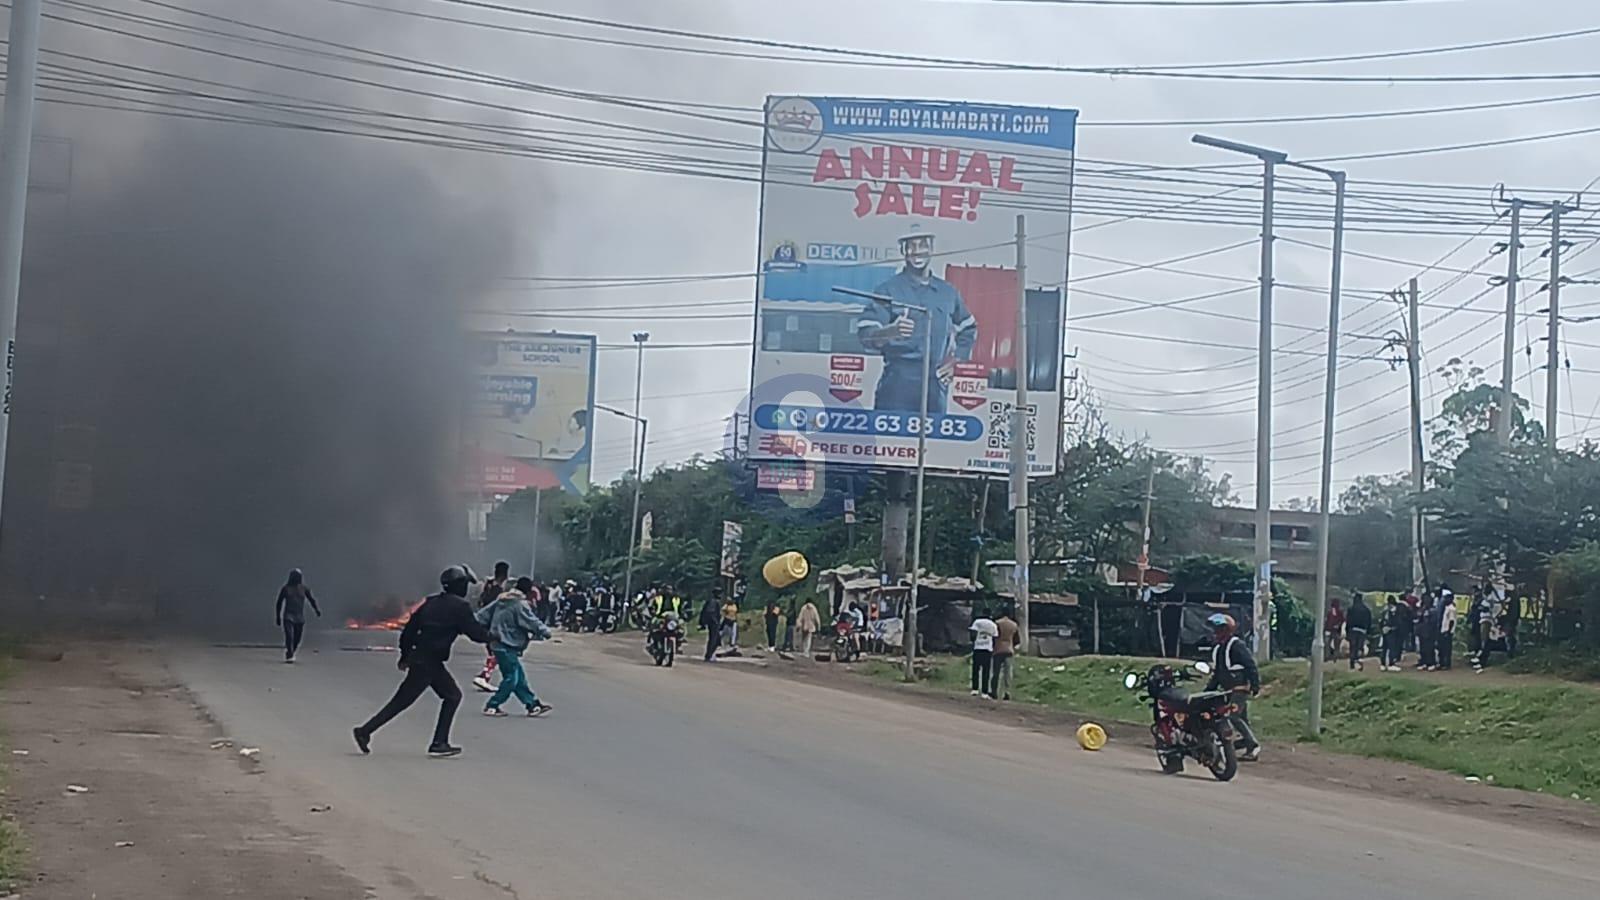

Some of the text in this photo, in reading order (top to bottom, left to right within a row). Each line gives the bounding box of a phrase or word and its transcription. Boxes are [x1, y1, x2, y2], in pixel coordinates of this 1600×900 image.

[833, 106, 1049, 134] WWW.ROYALMABATI.COM
[812, 146, 1023, 192] ANNUAL
[854, 181, 982, 222] SALE!
[808, 244, 856, 259] DEKA
[816, 411, 967, 437] 0722 63 83 83
[811, 442, 848, 454] FREE
